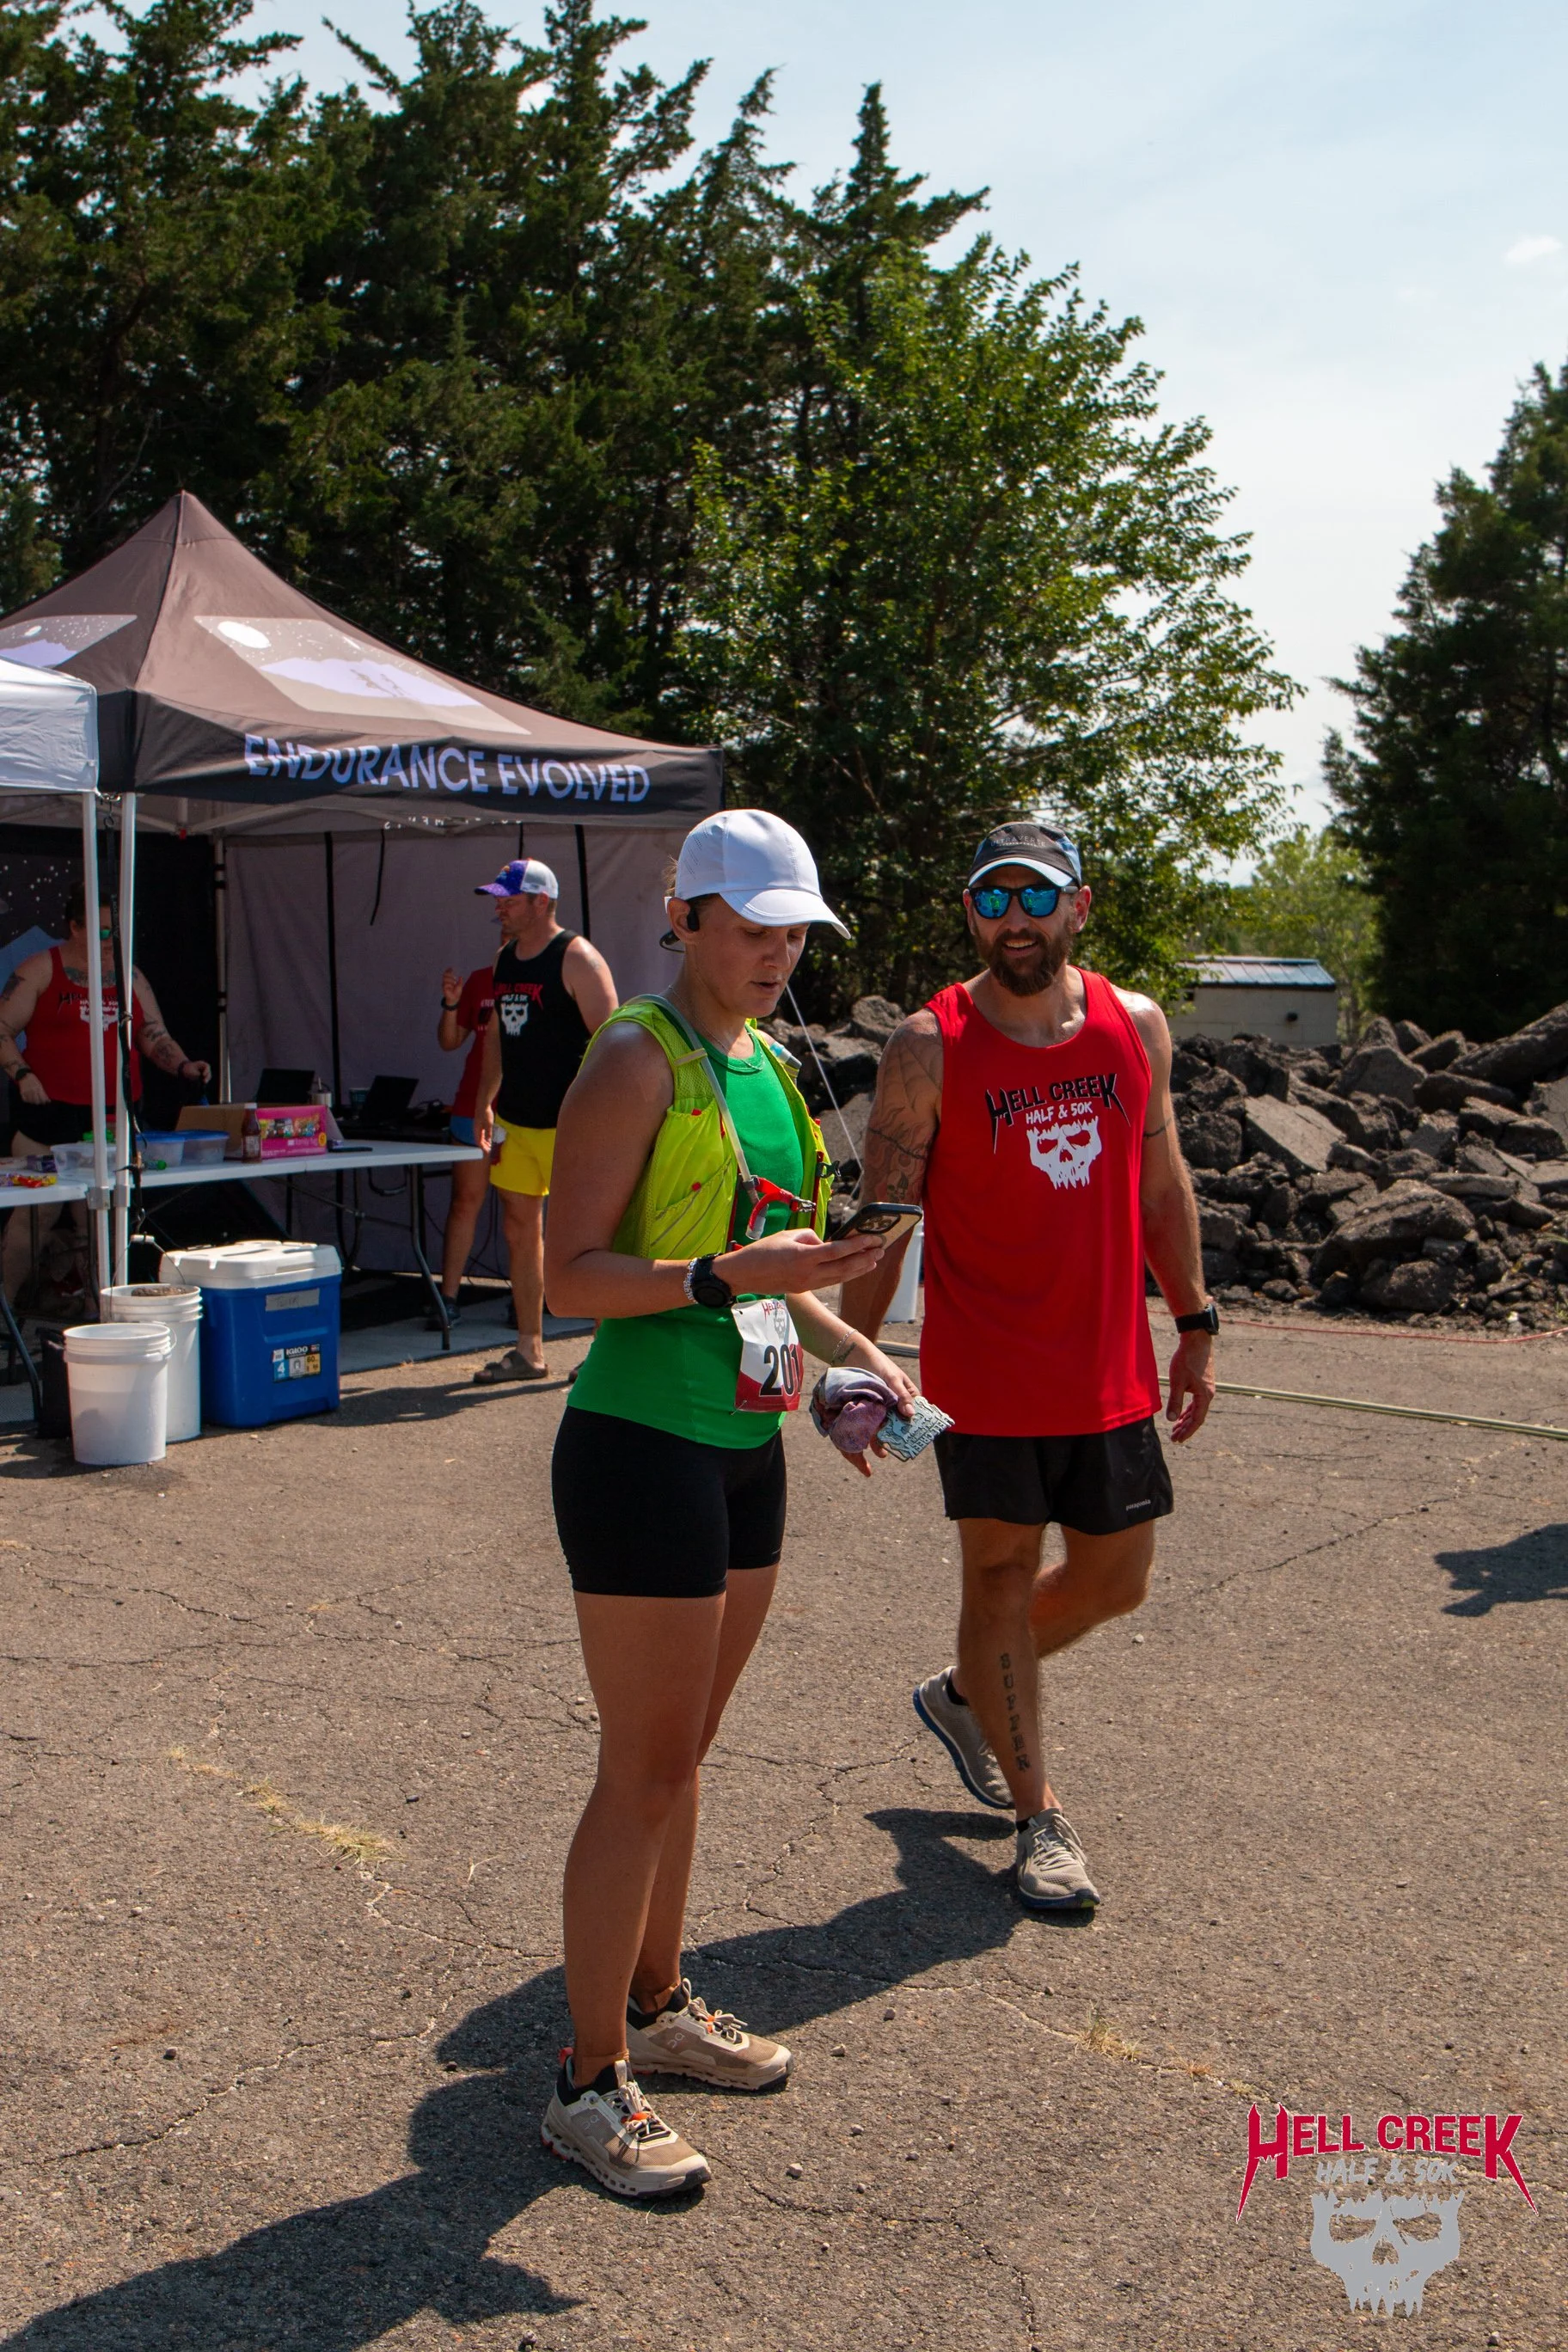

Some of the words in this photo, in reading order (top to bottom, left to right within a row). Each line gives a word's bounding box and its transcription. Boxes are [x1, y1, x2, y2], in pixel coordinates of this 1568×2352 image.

[244, 733, 487, 793] ENDURANCE
[496, 753, 651, 804] EVOLVED
[984, 1086, 1047, 1155] HELL
[1049, 1073, 1131, 1127] CREEK
[1026, 1106, 1054, 1125] HALF
[1058, 1106, 1068, 1119] &
[1070, 1101, 1093, 1117] 50K
[285, 1346, 309, 1355] IGLOO
[277, 1362, 285, 1374] 4
